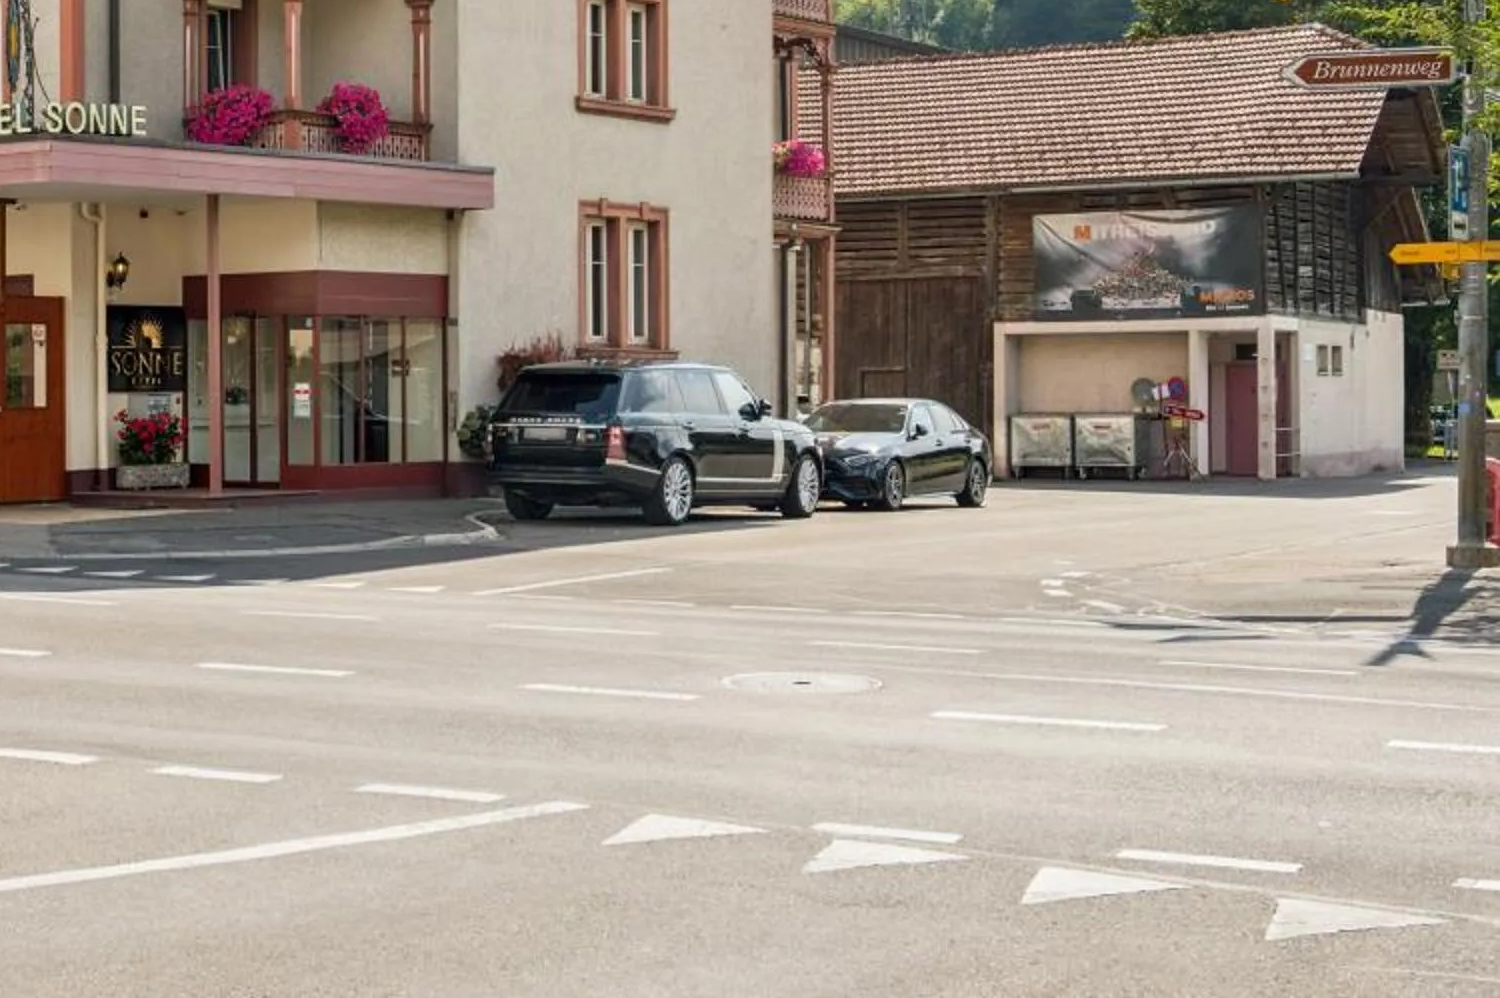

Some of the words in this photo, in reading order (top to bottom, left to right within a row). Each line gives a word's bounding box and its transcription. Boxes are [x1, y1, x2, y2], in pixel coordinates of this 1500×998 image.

[1313, 59, 1443, 79] Brunnenweg
[45, 102, 148, 136] SONNE
[111, 351, 182, 376] SONNE
